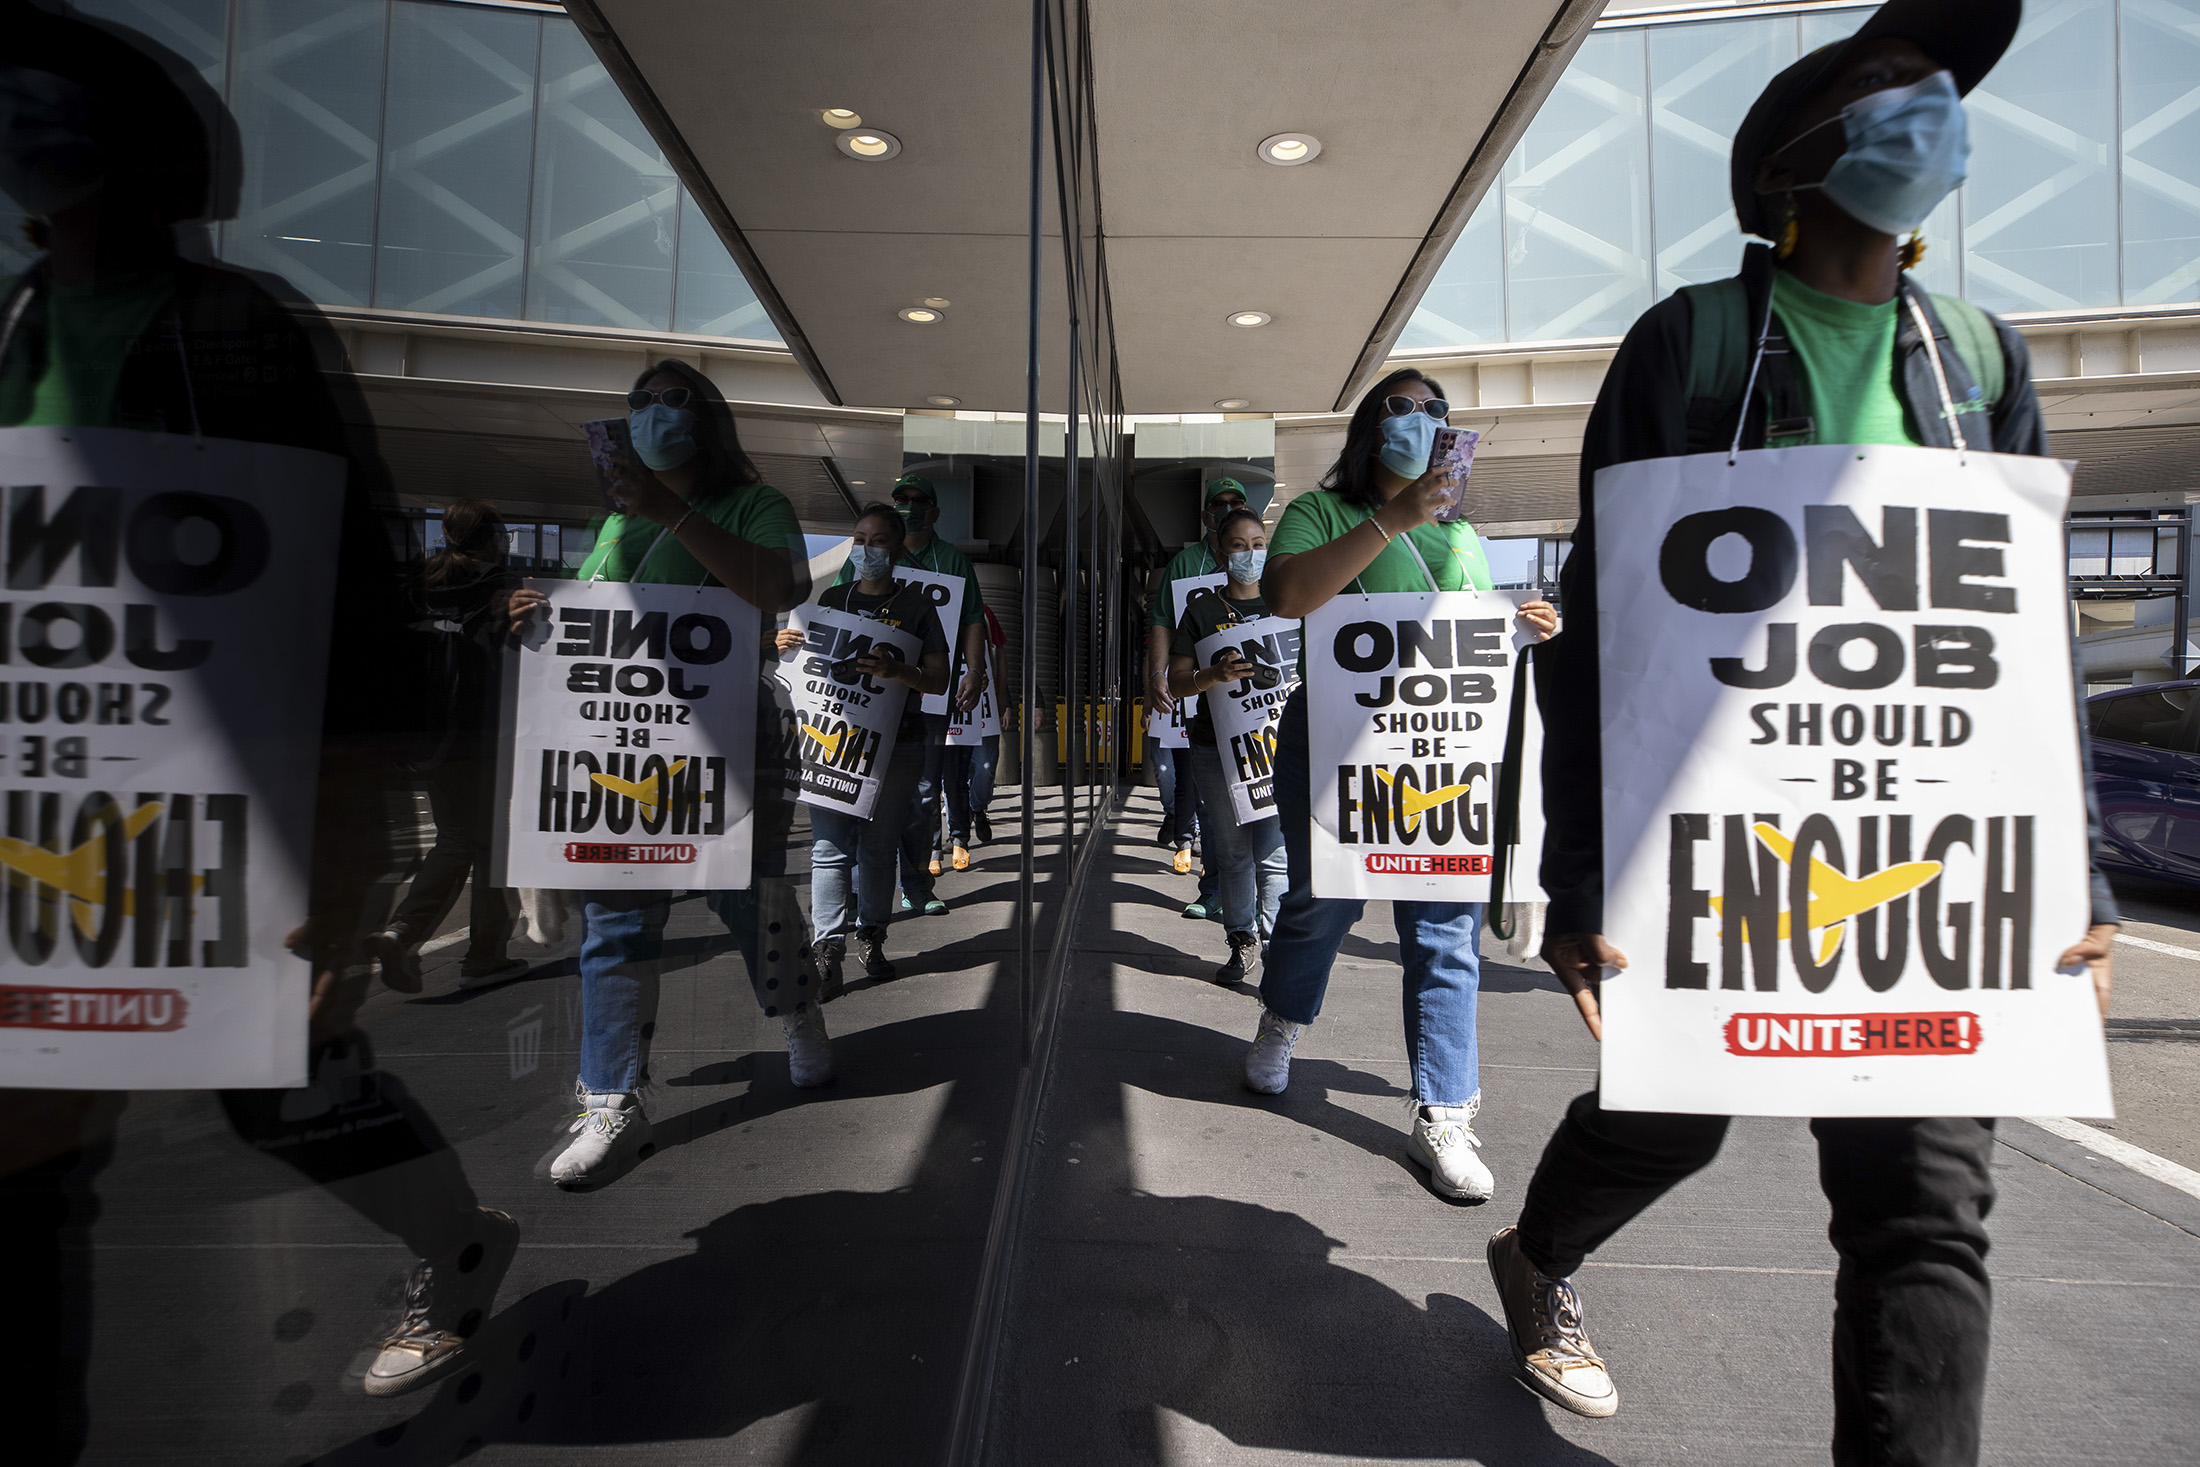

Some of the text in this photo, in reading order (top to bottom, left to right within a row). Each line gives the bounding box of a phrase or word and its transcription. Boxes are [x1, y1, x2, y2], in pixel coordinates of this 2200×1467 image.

[1659, 504, 2019, 615] ONE
[1333, 617, 1509, 673] ONE
[1710, 622, 2000, 690] JOB
[1354, 673, 1497, 708] JOB
[1267, 706, 1284, 721] B
[1373, 711, 1483, 734] SHOULD
[1750, 702, 1972, 747] SHOULD
[1411, 737, 1446, 758] BE
[1832, 758, 1899, 801] BE
[1338, 761, 1521, 846] ENOUG
[1664, 813, 2036, 994] ENOUGH
